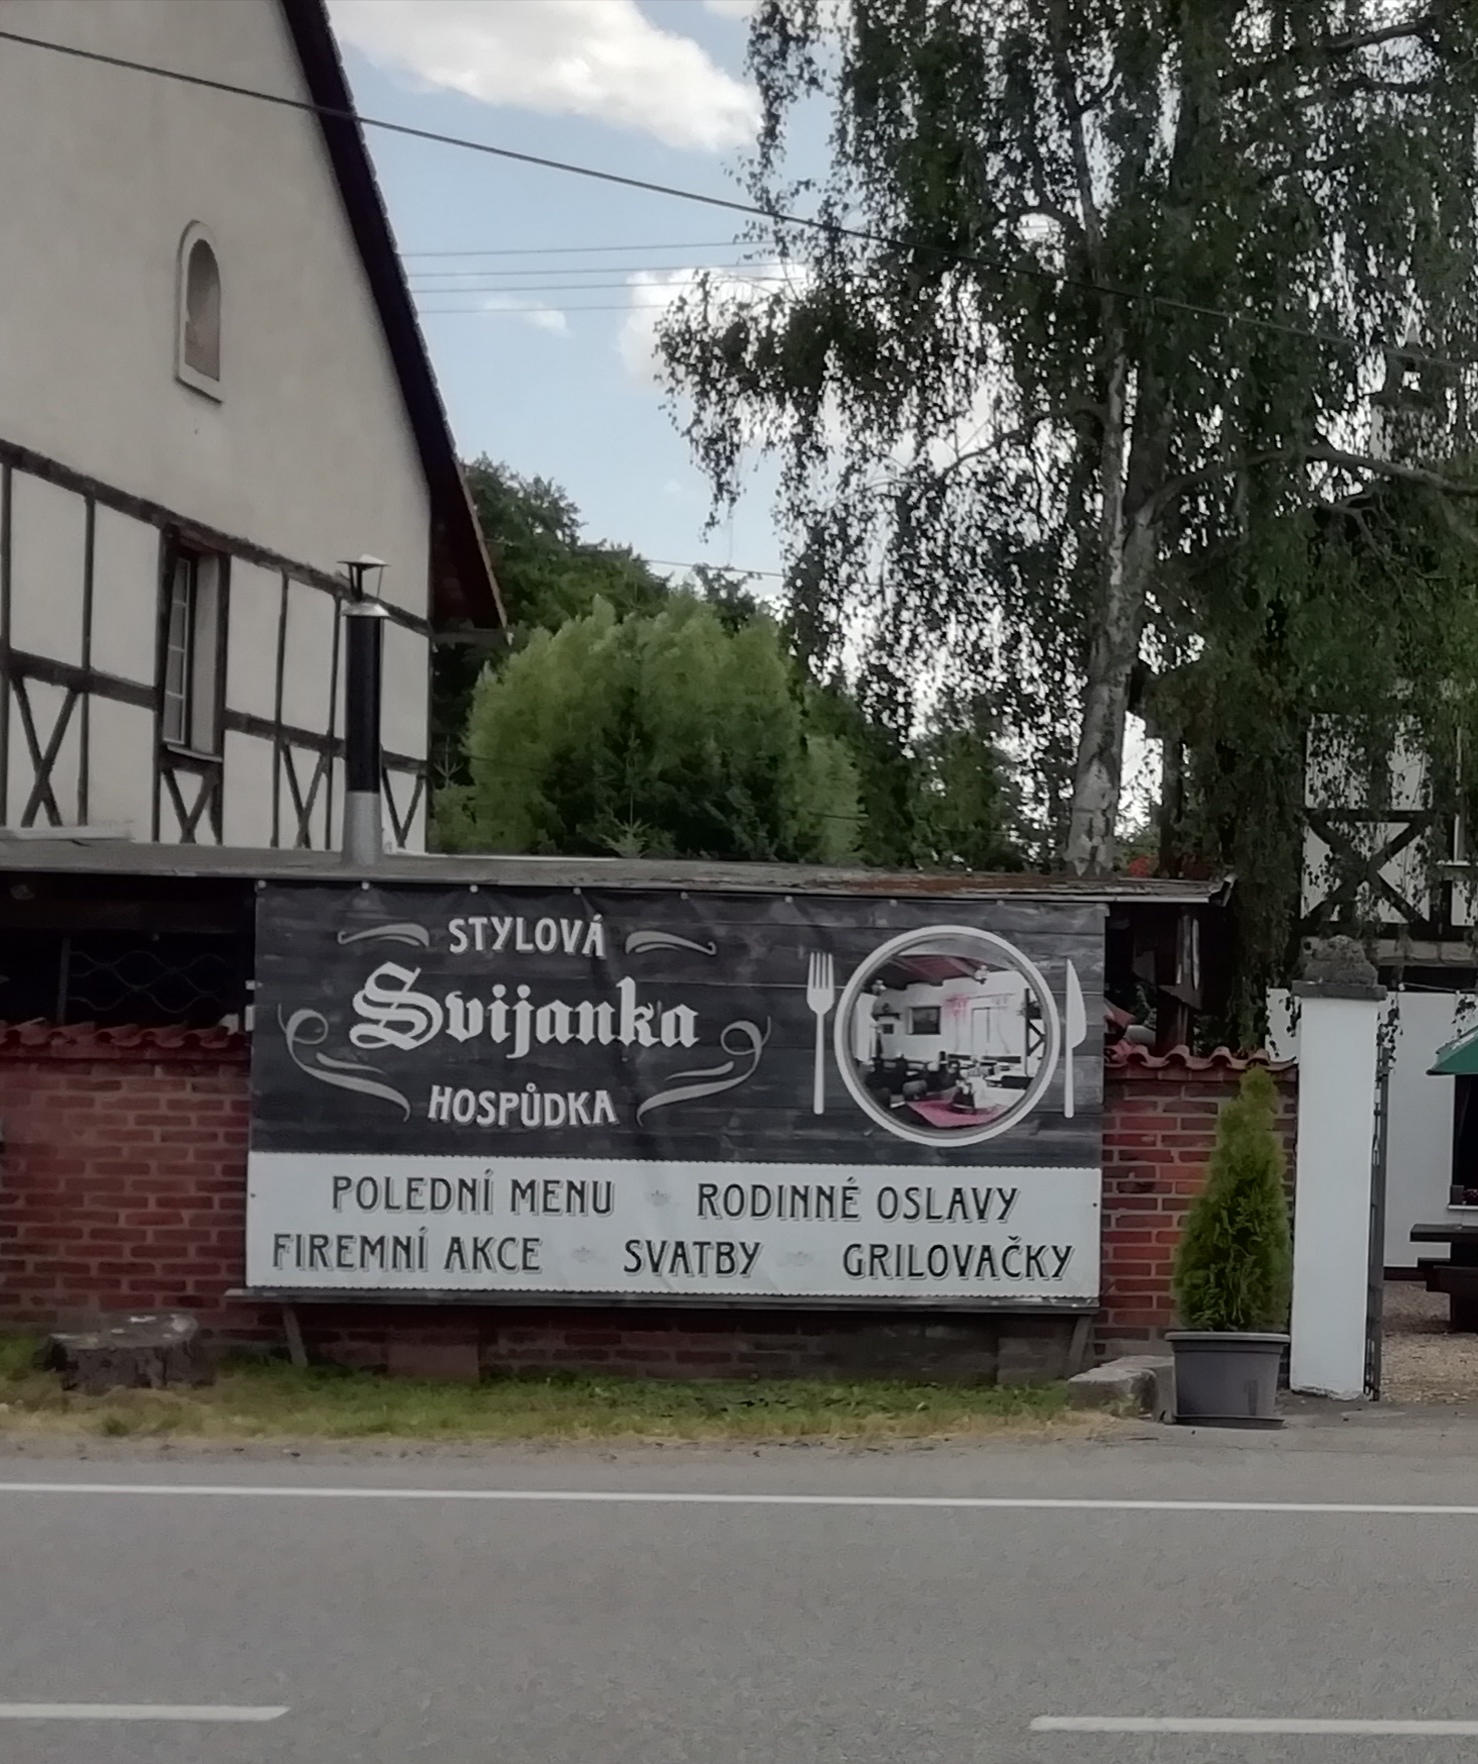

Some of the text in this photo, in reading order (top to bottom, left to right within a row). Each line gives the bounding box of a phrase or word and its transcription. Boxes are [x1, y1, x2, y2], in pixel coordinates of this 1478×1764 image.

[449, 914, 606, 957] STYLOVÁ
[349, 961, 700, 1060] Svijanka
[427, 1082, 620, 1128] HOSPŮDKA
[332, 1168, 616, 1216] POLEDNÍ MENU
[696, 1176, 1020, 1223] RODINNÉ OSLAVY
[271, 1226, 544, 1274] FIREMNÍ AKCE
[622, 1238, 763, 1279] SVATBY
[842, 1235, 1075, 1282] GRILOVAČKY
